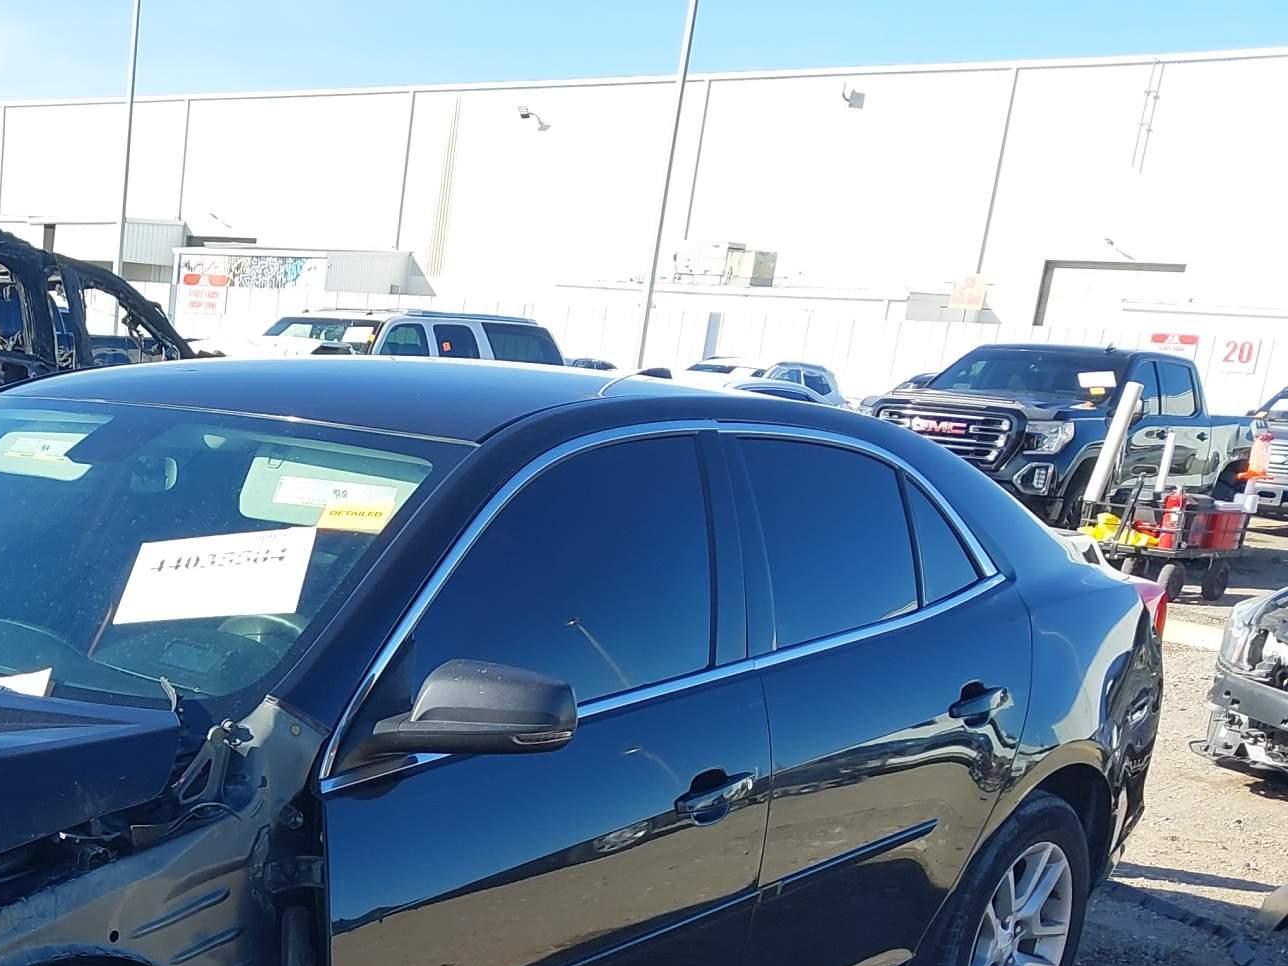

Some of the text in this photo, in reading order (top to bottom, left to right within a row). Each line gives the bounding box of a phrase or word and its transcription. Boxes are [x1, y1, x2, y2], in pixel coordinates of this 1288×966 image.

[1222, 340, 1254, 364] 20
[910, 416, 968, 435] GMC
[328, 510, 383, 518] DETAILED
